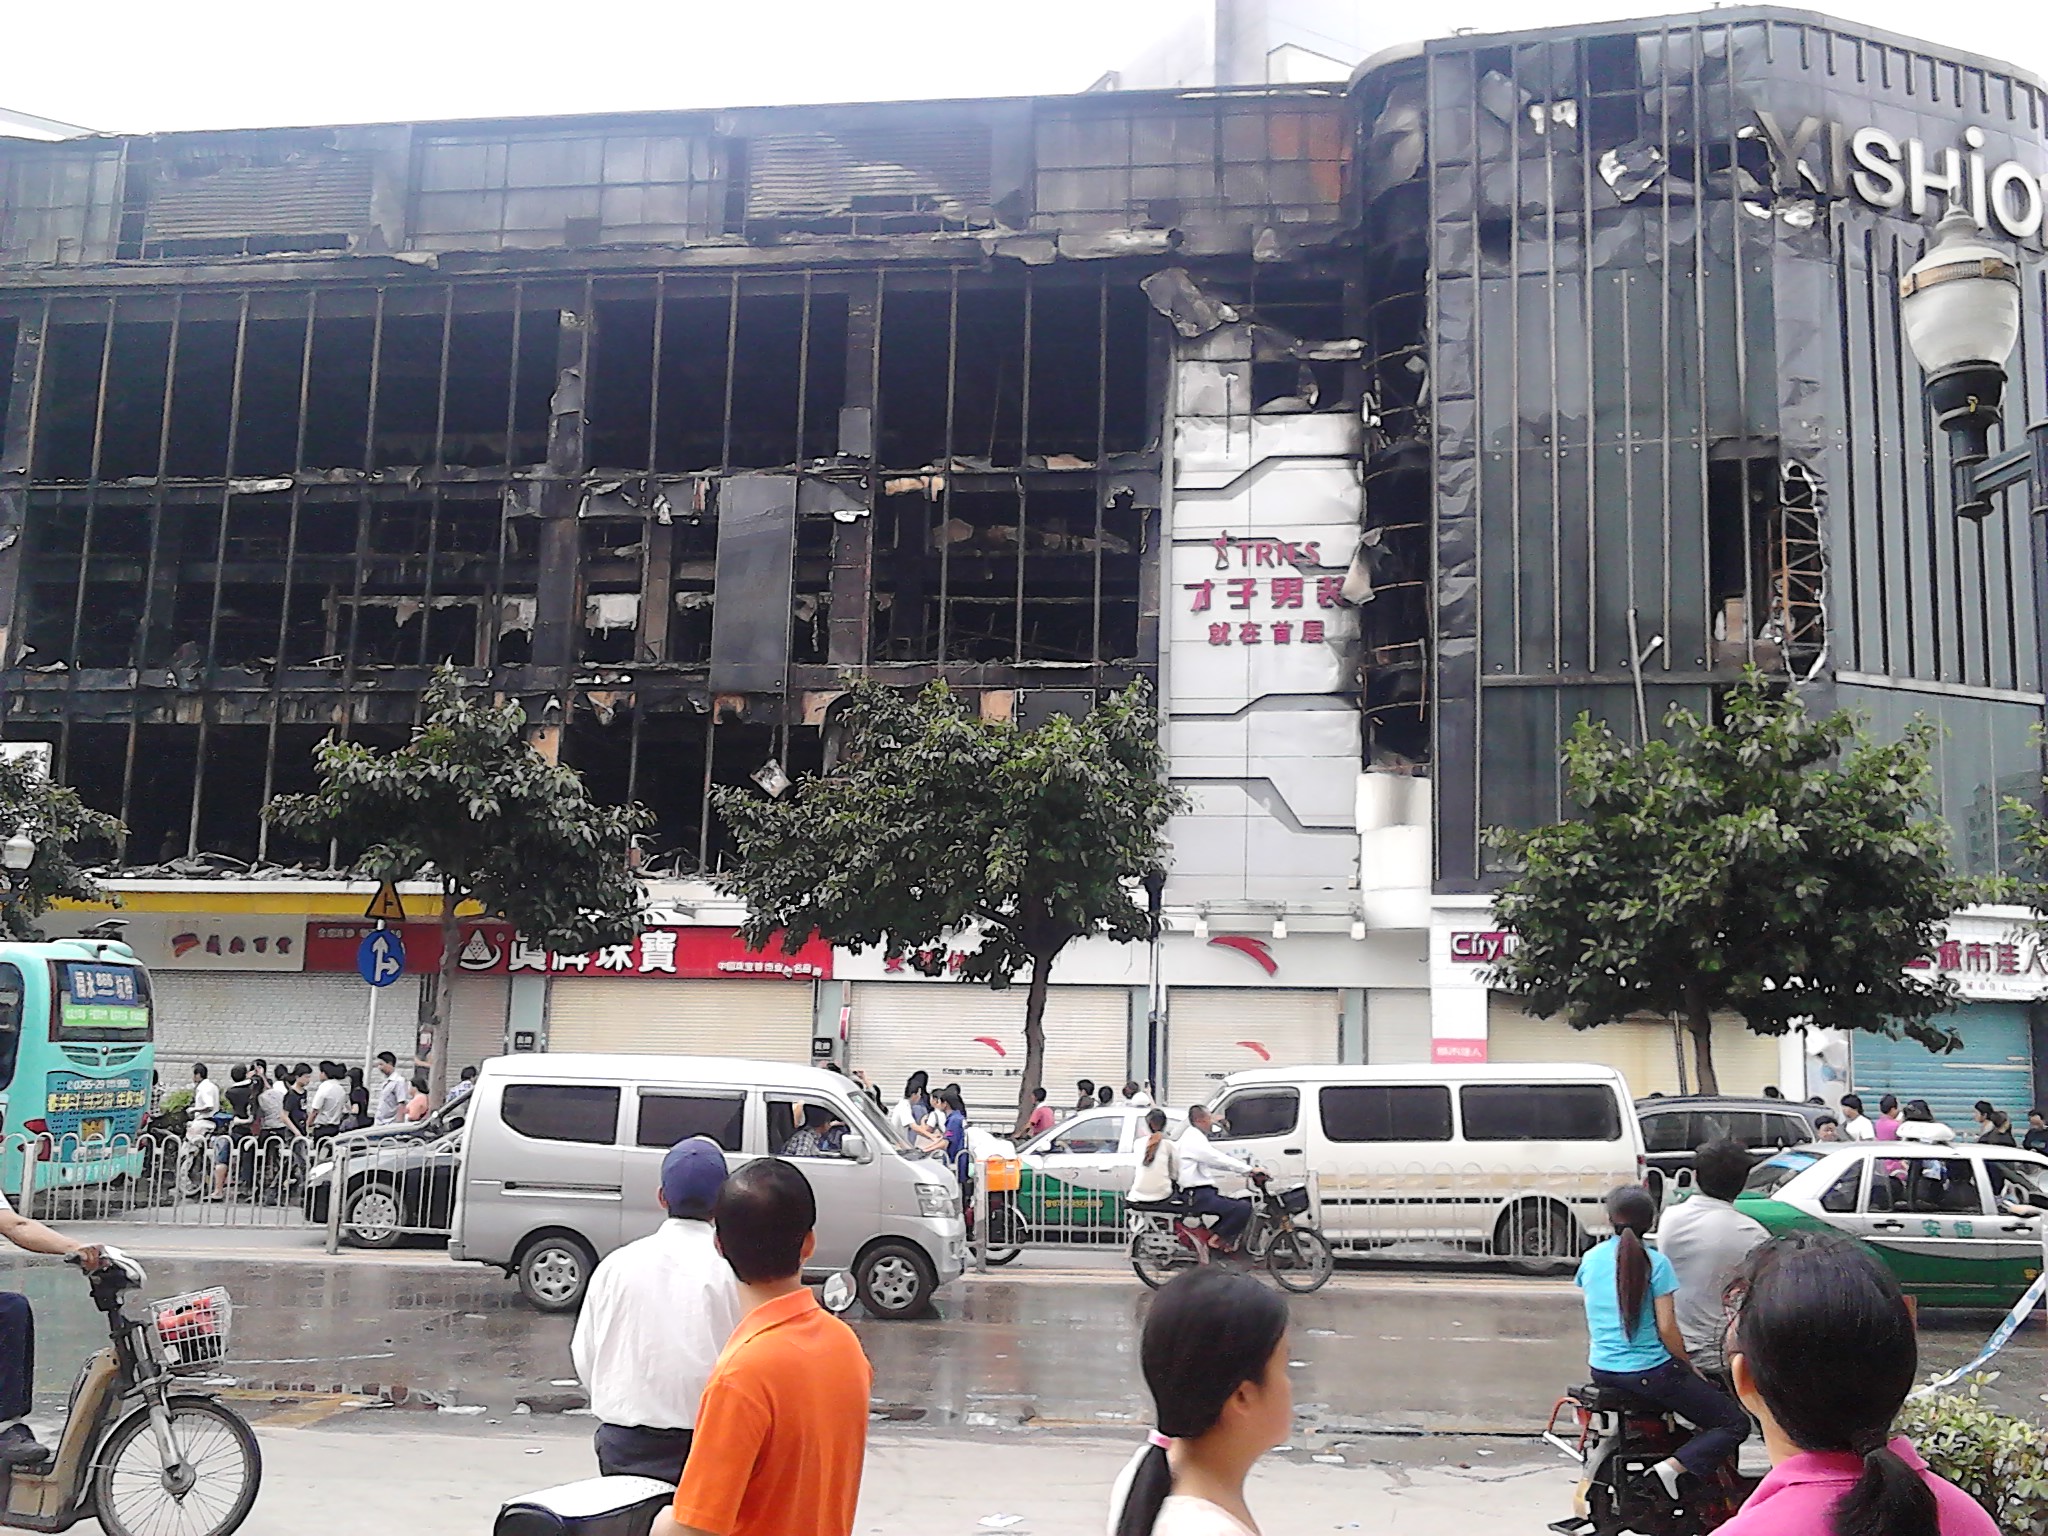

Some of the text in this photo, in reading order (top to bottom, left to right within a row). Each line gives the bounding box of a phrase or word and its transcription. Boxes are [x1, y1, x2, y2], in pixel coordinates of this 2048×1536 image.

[1208, 620, 1325, 646] 就在首层
[1452, 933, 1500, 960] City
